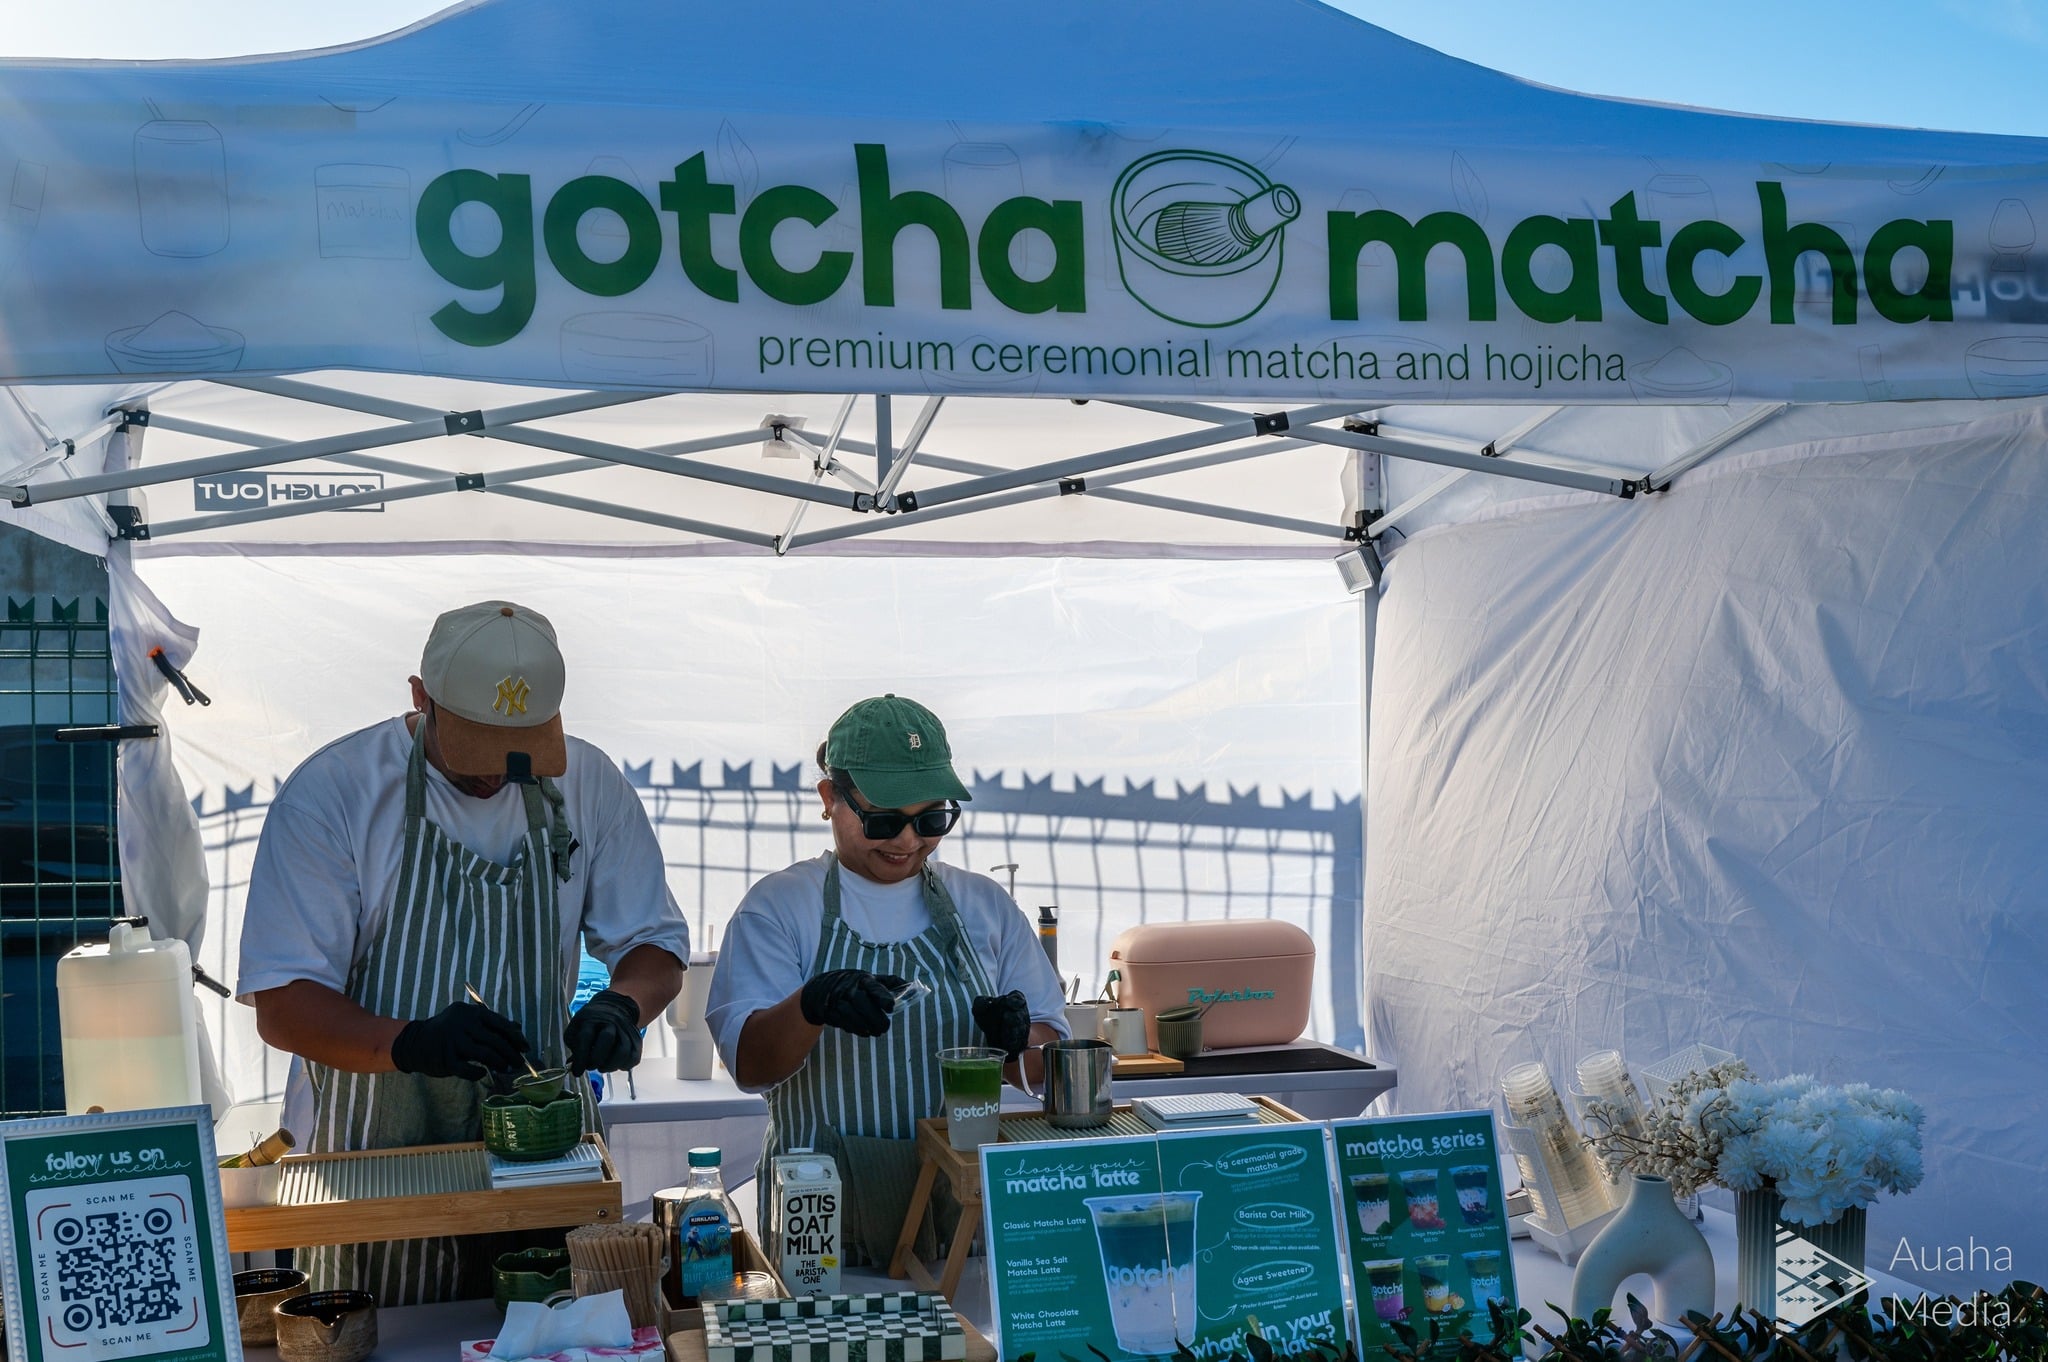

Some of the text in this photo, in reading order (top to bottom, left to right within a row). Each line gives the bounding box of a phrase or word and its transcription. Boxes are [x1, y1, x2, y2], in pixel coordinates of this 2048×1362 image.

[415, 142, 1955, 348] gotcha matcha
[758, 332, 1627, 389] premium ceremonial matcha and hojicha
[954, 1101, 999, 1121] gotcha
[1346, 1129, 1486, 1156] matcha series
[46, 1148, 164, 1171] follow us on
[1231, 1152, 1276, 1166] ceremonial
[1279, 1147, 1303, 1158] grade
[29, 1153, 192, 1183] social media
[1004, 1158, 1145, 1178] choose your
[1246, 1162, 1279, 1174] matcha
[1006, 1169, 1140, 1194] matcha latte
[86, 1193, 136, 1205] SCAN ME
[787, 1194, 836, 1214] OTIS
[691, 1215, 720, 1223] KIRKLAND
[1239, 1211, 1267, 1219] Barista
[1270, 1210, 1286, 1219] Oat
[788, 1214, 834, 1235] OAT
[1003, 1217, 1087, 1230] Classic Matcha Latte
[184, 1235, 196, 1282] SCAN ME
[801, 1260, 816, 1268] THE
[1006, 1256, 1068, 1268] Vanilla Sea Salt
[38, 1253, 50, 1301] SCAN ME
[796, 1267, 827, 1277] BARISTA
[1007, 1266, 1061, 1277] Matcha Latte
[802, 1276, 821, 1284] ONE
[1237, 1275, 1263, 1286] Agave
[1011, 1309, 1079, 1321] White Chocolate
[1012, 1319, 1066, 1331] Matcha Latte
[1286, 1309, 1332, 1340] your
[102, 1332, 152, 1346] SCAN ME
